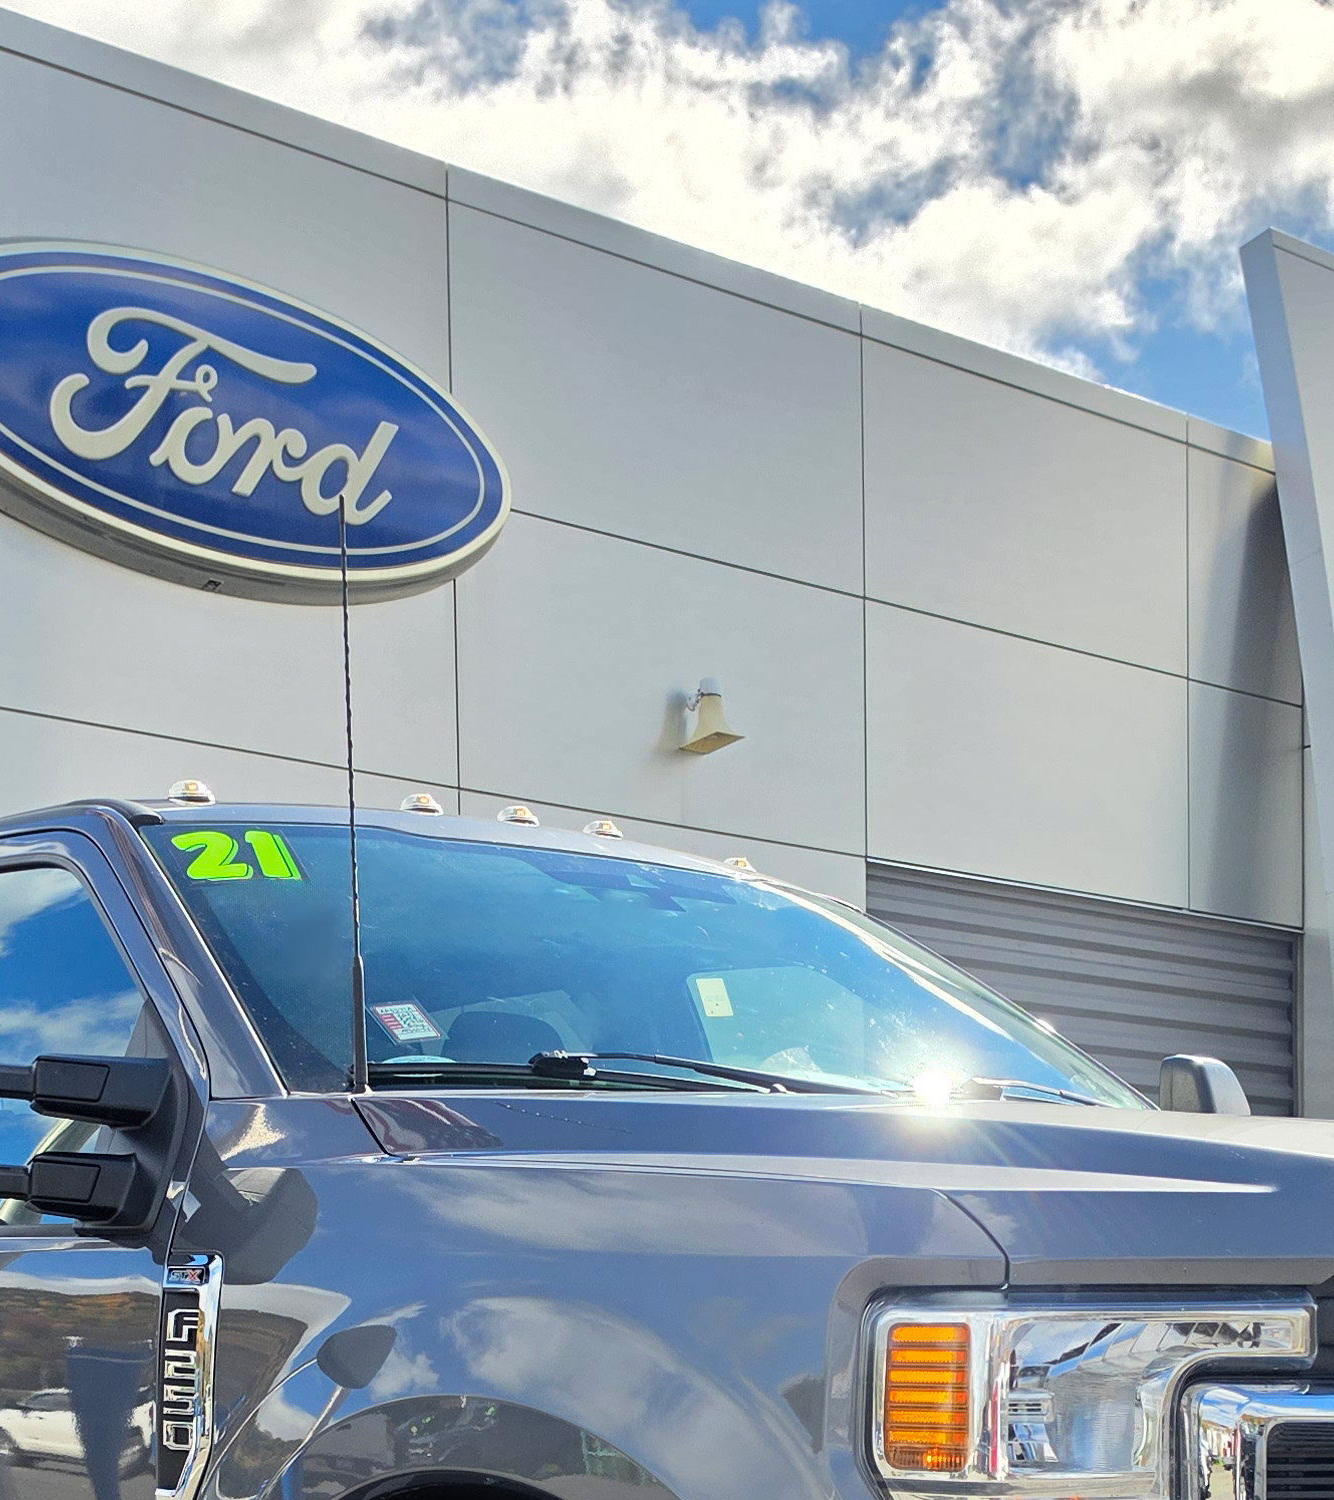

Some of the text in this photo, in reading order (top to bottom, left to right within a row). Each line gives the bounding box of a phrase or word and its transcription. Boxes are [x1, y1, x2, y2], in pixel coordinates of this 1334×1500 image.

[50, 307, 399, 525] Ford
[171, 831, 301, 880] 21
[169, 1269, 202, 1283] STX
